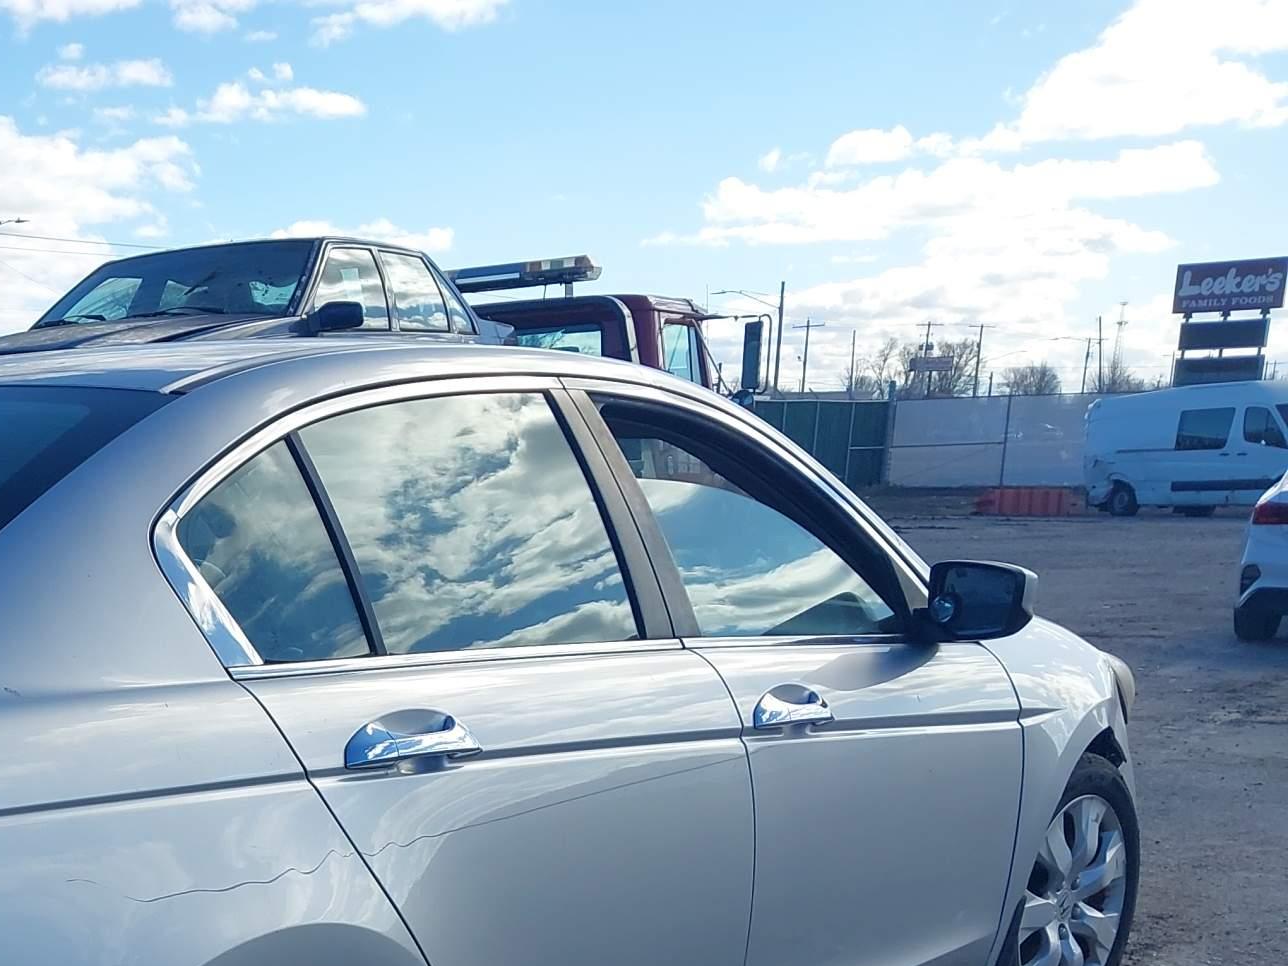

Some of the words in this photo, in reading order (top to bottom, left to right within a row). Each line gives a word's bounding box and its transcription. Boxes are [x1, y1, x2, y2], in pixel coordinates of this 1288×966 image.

[1178, 268, 1283, 296] Leeker's
[1182, 298, 1228, 308] FAMILY
[1231, 295, 1274, 306] FOODS
